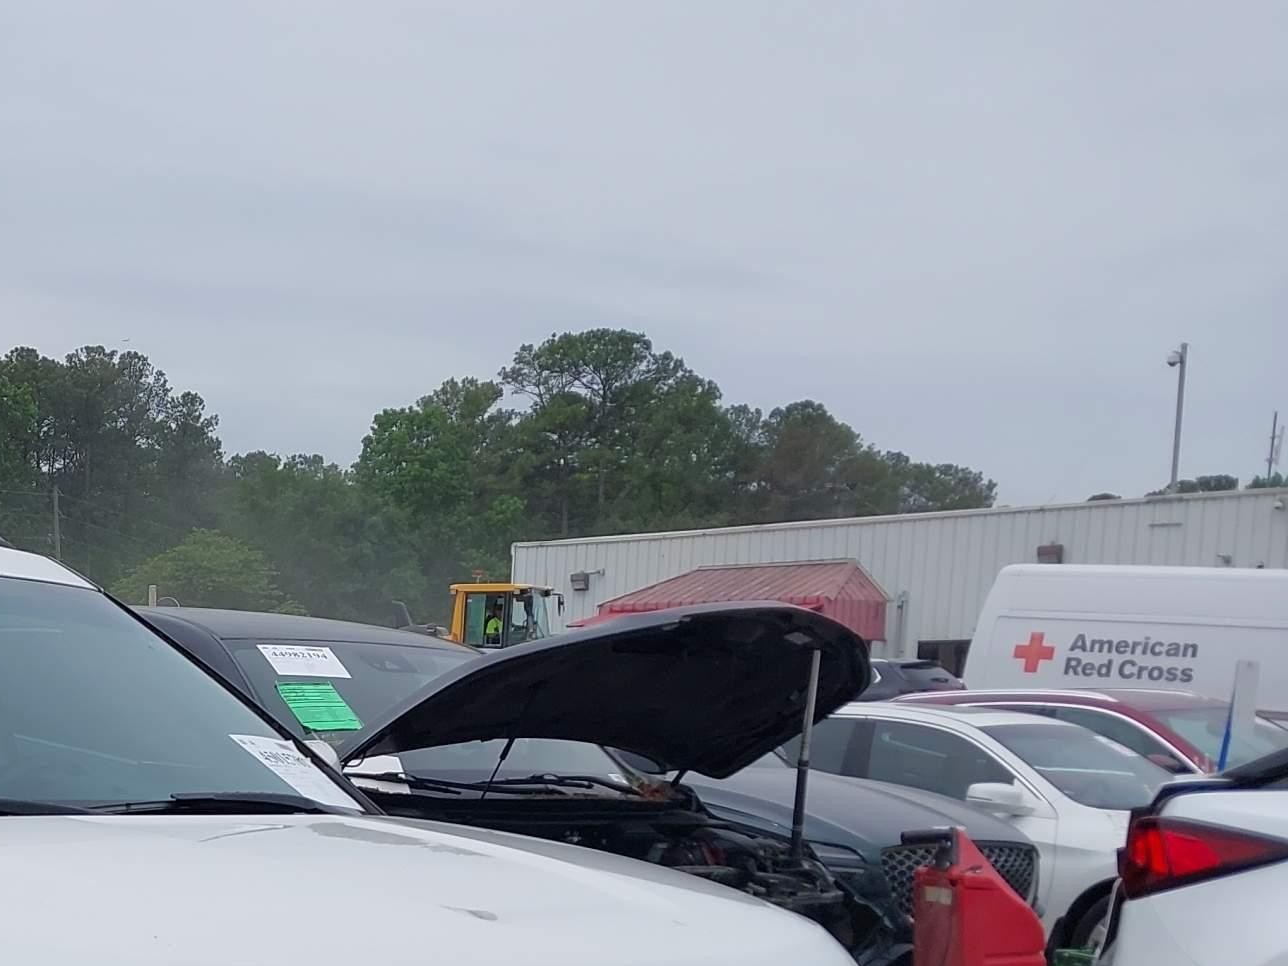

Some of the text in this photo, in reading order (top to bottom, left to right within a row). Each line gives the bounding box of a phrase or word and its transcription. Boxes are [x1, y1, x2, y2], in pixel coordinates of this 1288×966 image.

[1069, 634, 1198, 658] American
[1063, 657, 1193, 682] Red Cross
